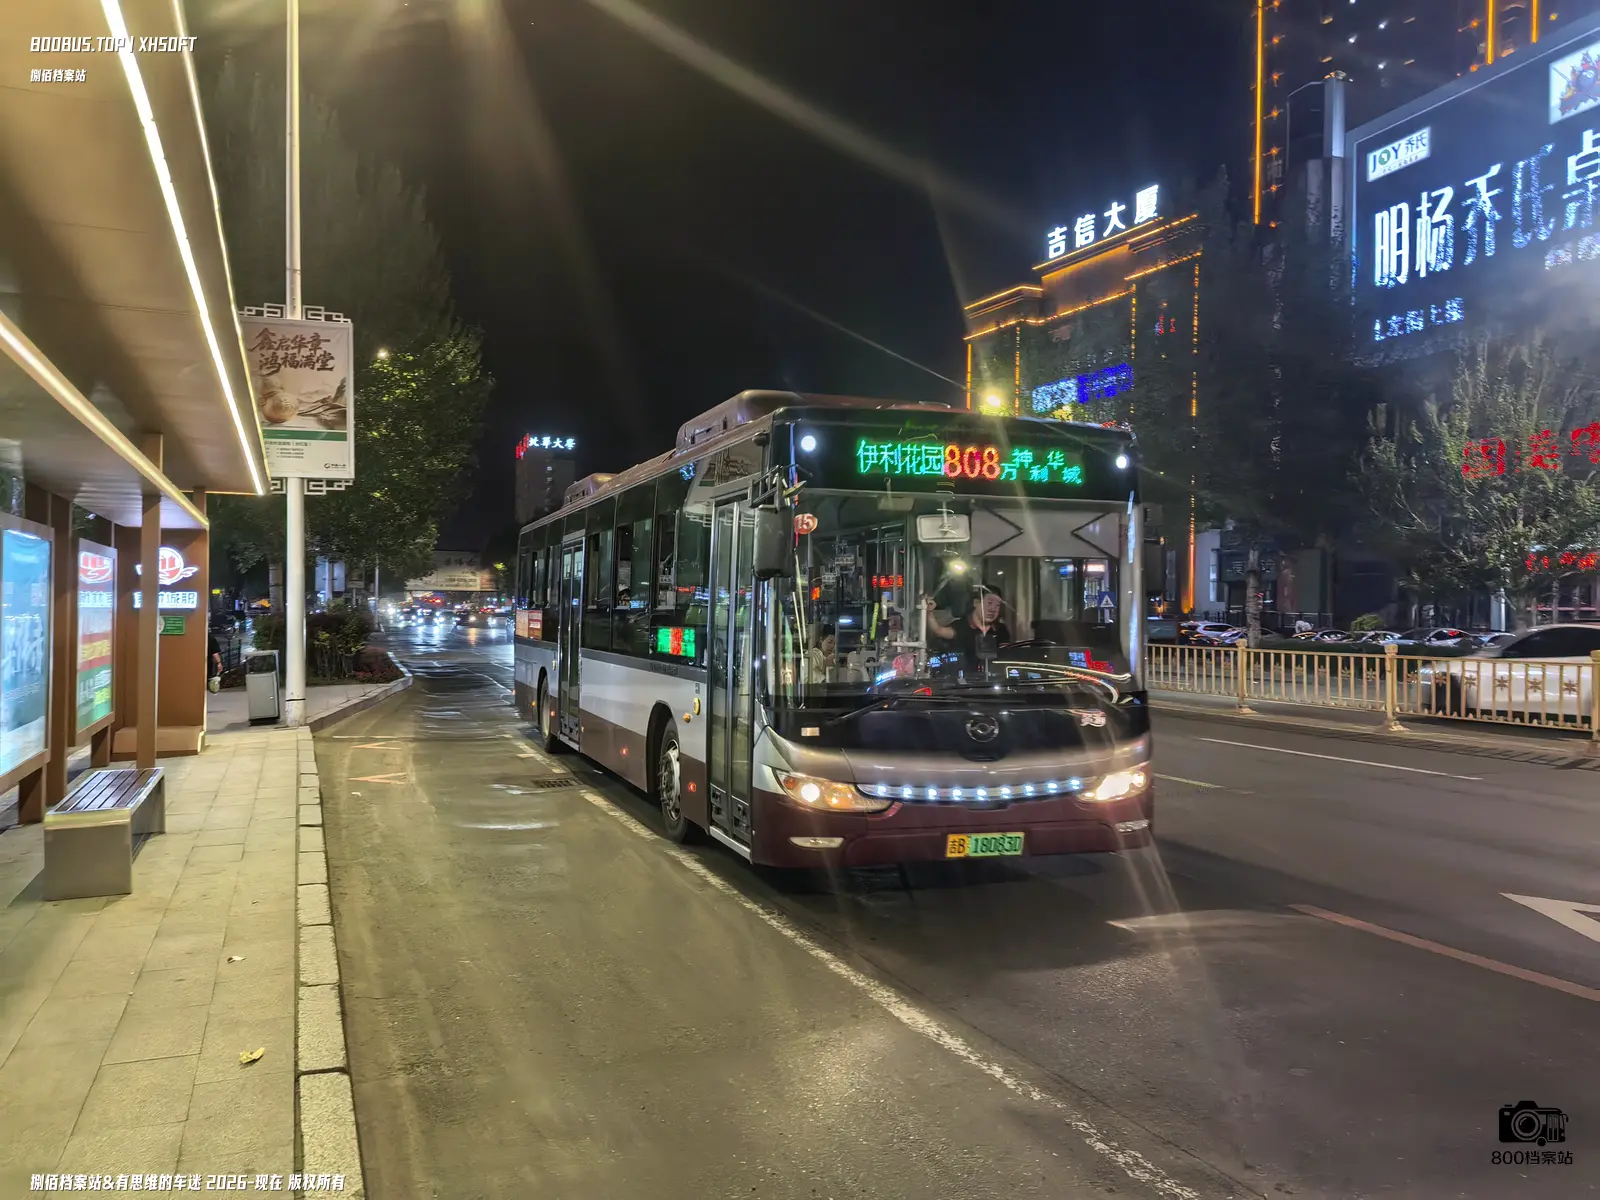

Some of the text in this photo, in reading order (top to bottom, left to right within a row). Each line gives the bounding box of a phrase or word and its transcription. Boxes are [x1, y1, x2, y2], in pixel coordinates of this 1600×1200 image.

[1371, 143, 1401, 173] JOY
[1047, 184, 1159, 259] 吉信大厦
[248, 327, 331, 357] 鑫启华章
[257, 350, 336, 377] 鸿福满堂
[857, 439, 1001, 480] 伊利花园 808
